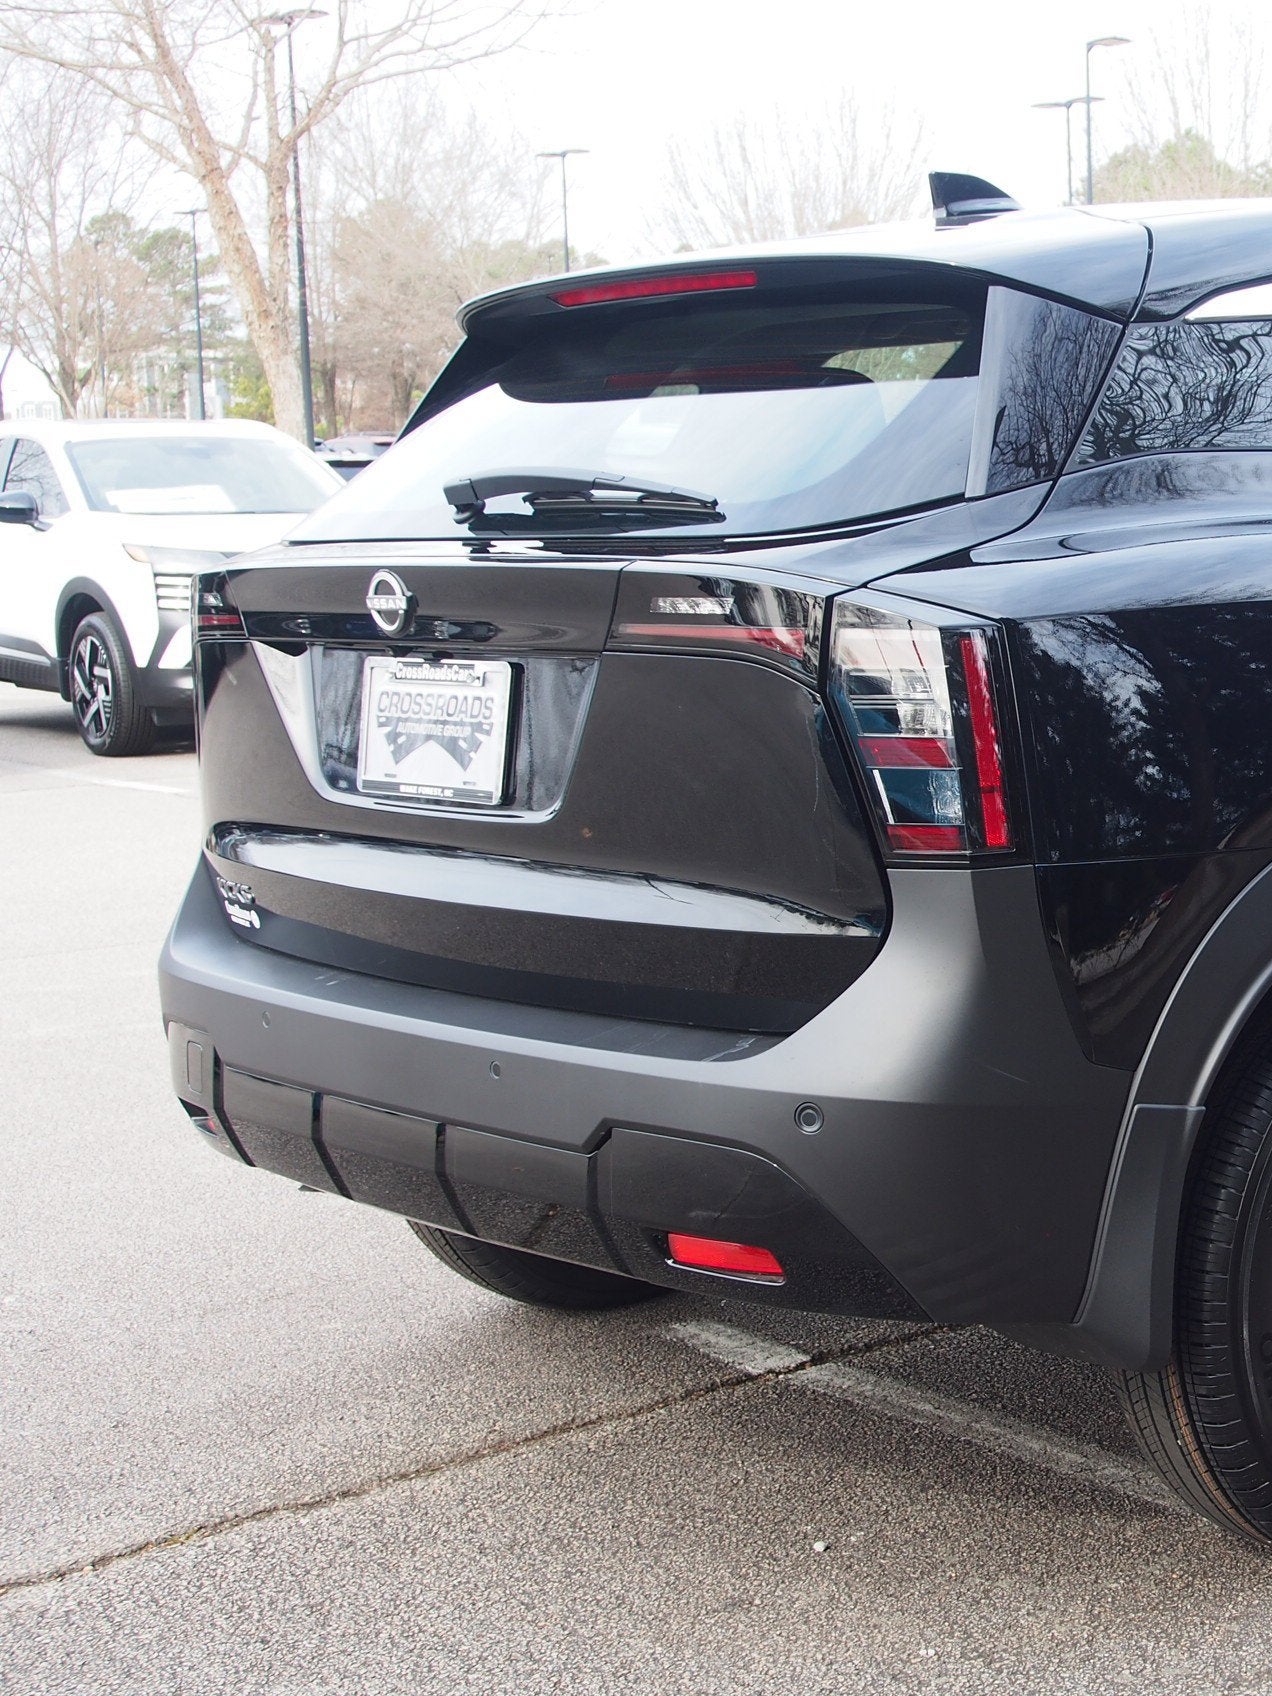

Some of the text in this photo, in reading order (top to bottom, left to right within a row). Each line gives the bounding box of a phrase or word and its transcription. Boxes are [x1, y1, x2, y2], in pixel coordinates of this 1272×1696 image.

[377, 691, 494, 719] CROSSROADS
[396, 721, 471, 738] AUTOMOTIVE GROUP
